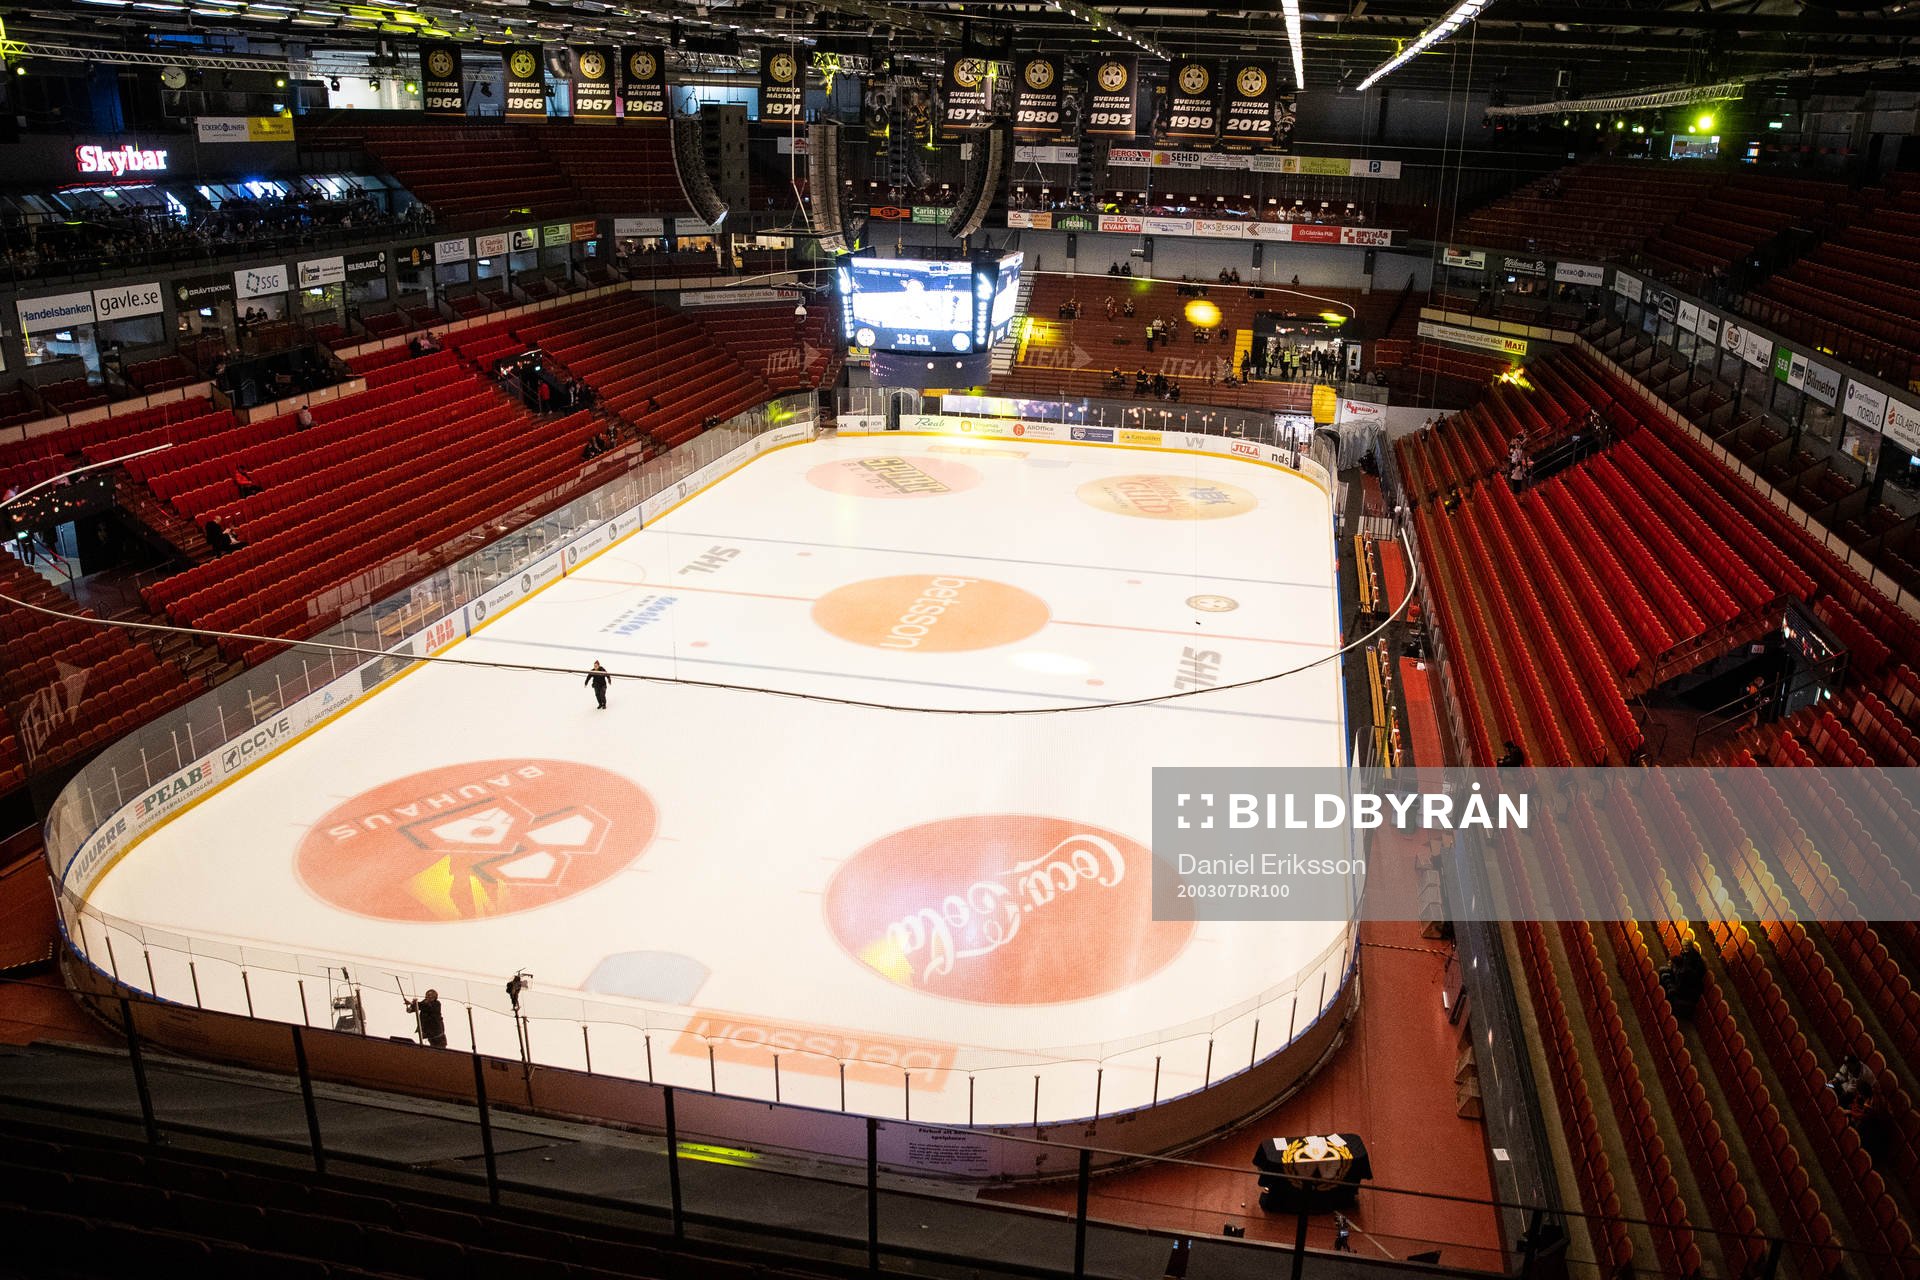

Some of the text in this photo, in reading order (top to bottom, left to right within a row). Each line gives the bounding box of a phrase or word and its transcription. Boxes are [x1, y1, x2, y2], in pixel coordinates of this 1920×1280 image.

[426, 98, 462, 108] 1964
[508, 98, 543, 110] 1966
[576, 98, 612, 110] 1967
[626, 100, 664, 112] 1968
[766, 103, 800, 115] 1971
[1230, 107, 1269, 115] MÄSTARE
[1016, 110, 1058, 123] 1980
[1090, 112, 1132, 125] 1993
[1170, 116, 1213, 128] 1999
[1226, 118, 1272, 132] 2012
[76, 145, 168, 176] Skybar
[1172, 153, 1200, 162] SEHED
[1103, 223, 1140, 231] KVANTUM
[261, 274, 279, 290] SSG
[100, 291, 158, 316] gavle.se
[20, 304, 92, 321] Handelsbanken
[767, 350, 800, 374] ITEM
[1777, 357, 1789, 371] SEB
[1806, 369, 1836, 398] Bilmetro
[1232, 444, 1259, 456] JULA
[678, 546, 741, 576] SHL
[880, 576, 978, 649] betsson
[425, 618, 456, 653] ABB
[1174, 646, 1222, 690] SHL
[241, 717, 290, 756] CCVE
[142, 766, 203, 814] PEAB
[328, 765, 546, 842] BAUHAUS
[74, 817, 127, 883] HUURRE
[888, 834, 1126, 984] Coca-Cola
[692, 1020, 944, 1083] betsson
